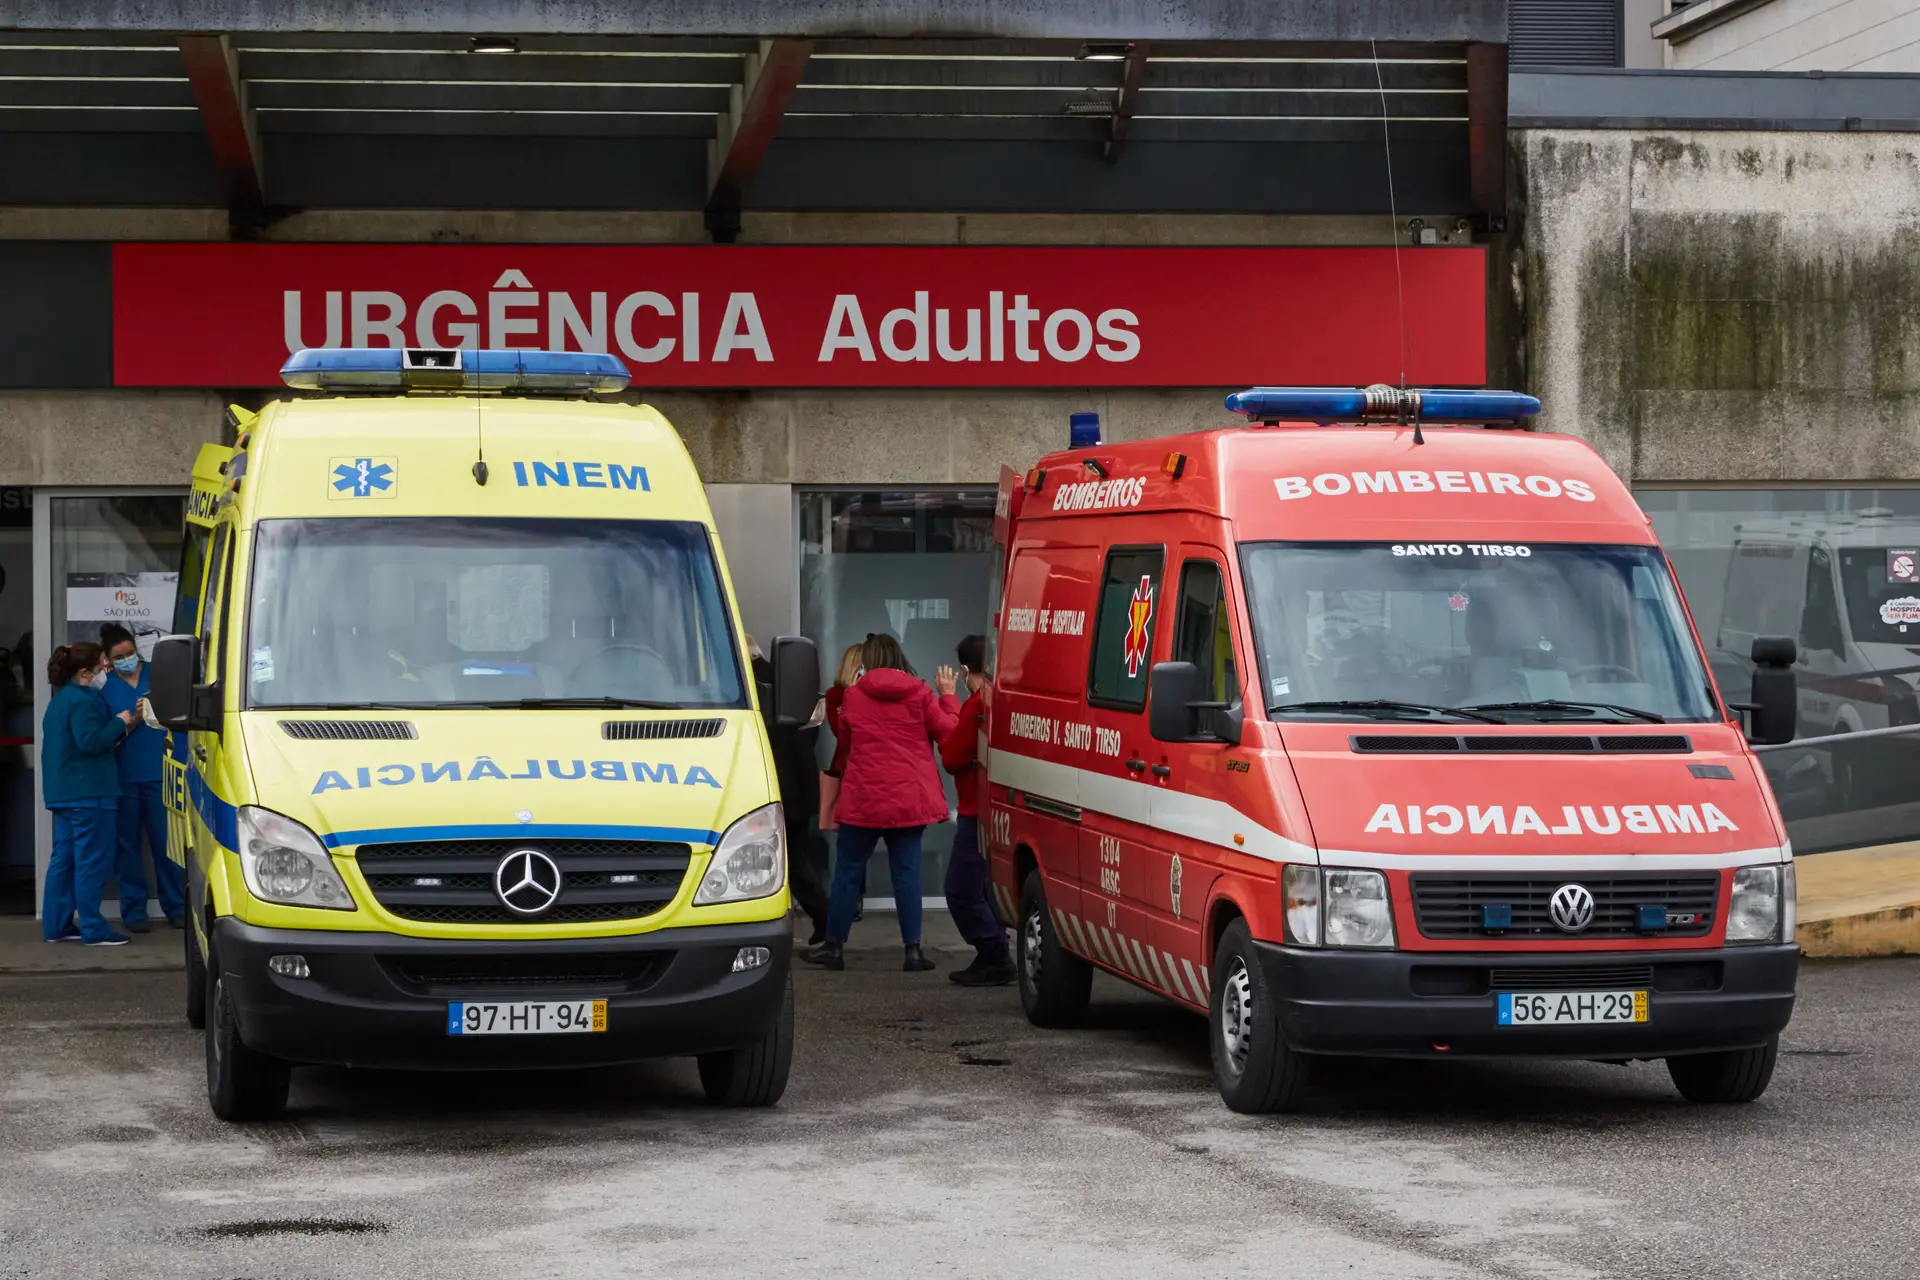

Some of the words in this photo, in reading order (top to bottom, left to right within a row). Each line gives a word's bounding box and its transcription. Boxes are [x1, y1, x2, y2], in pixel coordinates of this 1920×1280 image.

[284, 269, 775, 362] URGÊNCIA
[818, 290, 1141, 363] Adultos
[512, 461, 652, 492] INEM
[1273, 470, 1596, 502] BOMBEIROS
[1052, 476, 1147, 511] BOMBEIROS
[1391, 543, 1463, 557] SANTO
[1467, 544, 1531, 557] TIRSO
[1010, 712, 1051, 743] BOMBEIROS
[1064, 721, 1091, 751] SANTO
[1096, 727, 1121, 757] TIRSO
[1100, 835, 1120, 867] 1304
[1100, 867, 1120, 897] ABSC
[1107, 901, 1116, 928] 07
